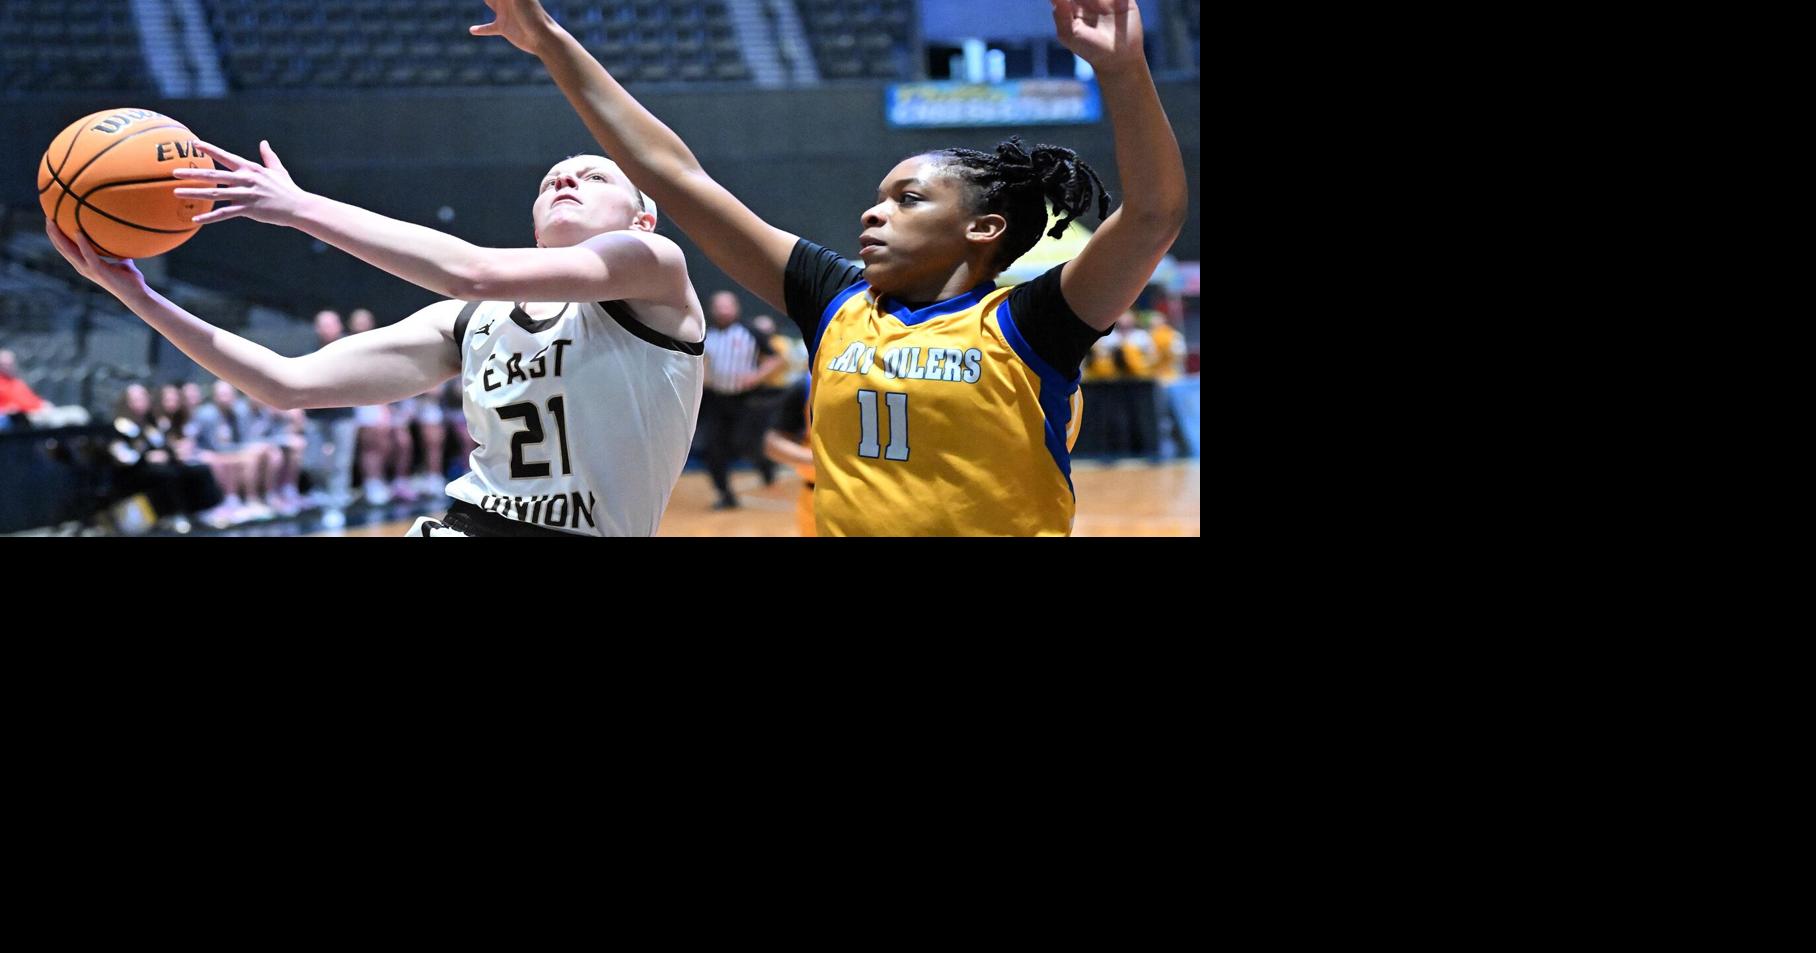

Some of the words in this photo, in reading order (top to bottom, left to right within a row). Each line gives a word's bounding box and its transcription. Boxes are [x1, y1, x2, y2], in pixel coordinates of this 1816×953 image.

[483, 339, 573, 392] EAST
[883, 347, 982, 383] OILERS
[496, 395, 574, 480] 21
[857, 389, 910, 461] 11
